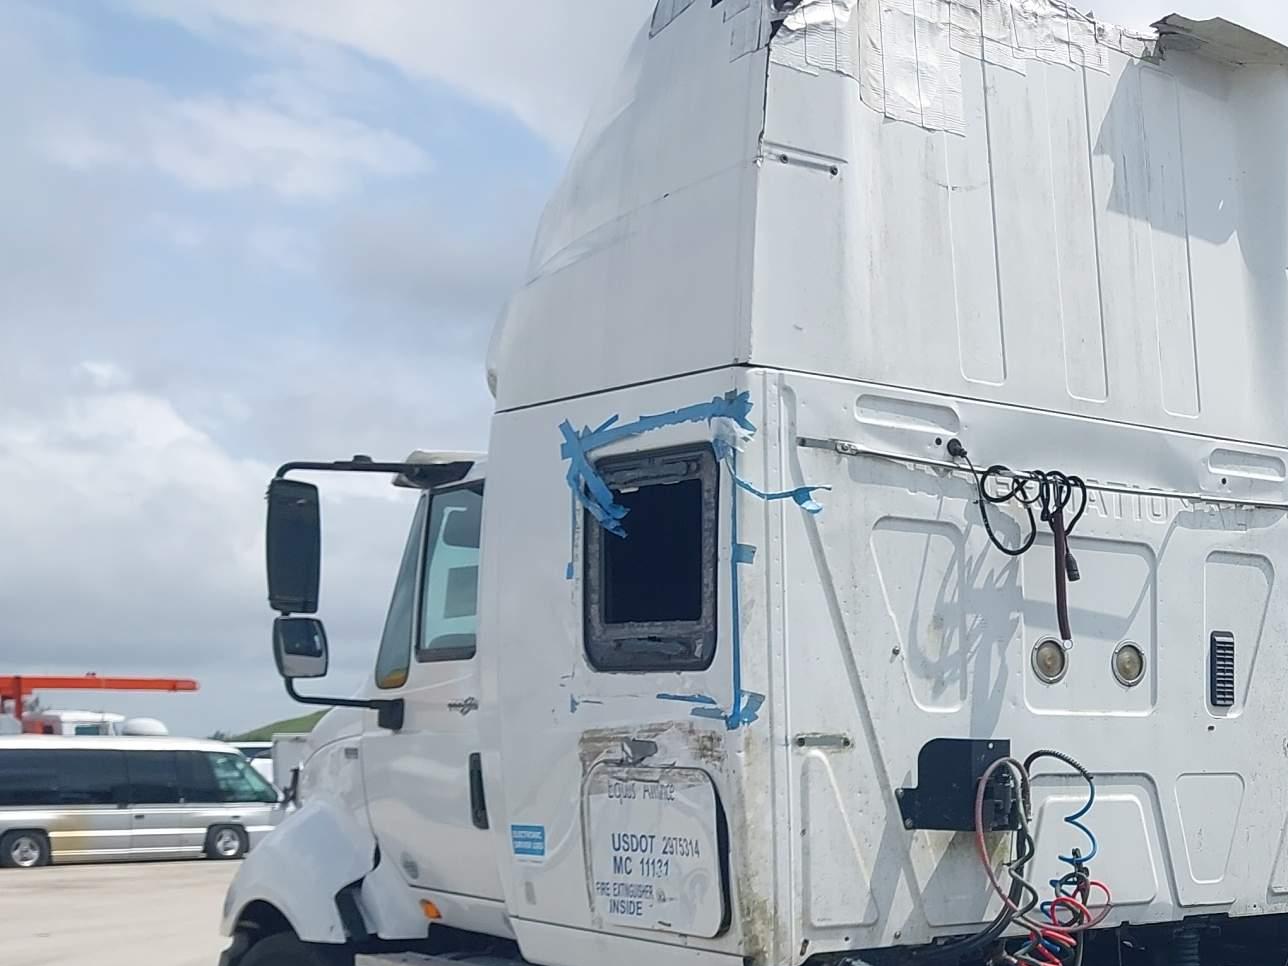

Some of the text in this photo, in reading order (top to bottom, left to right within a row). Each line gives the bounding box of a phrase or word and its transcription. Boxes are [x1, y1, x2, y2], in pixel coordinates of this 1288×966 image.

[612, 833, 700, 857] USDOT 2975314
[613, 856, 633, 875] MC
[596, 881, 610, 896] FIRE
[609, 899, 643, 916] INSIDE
